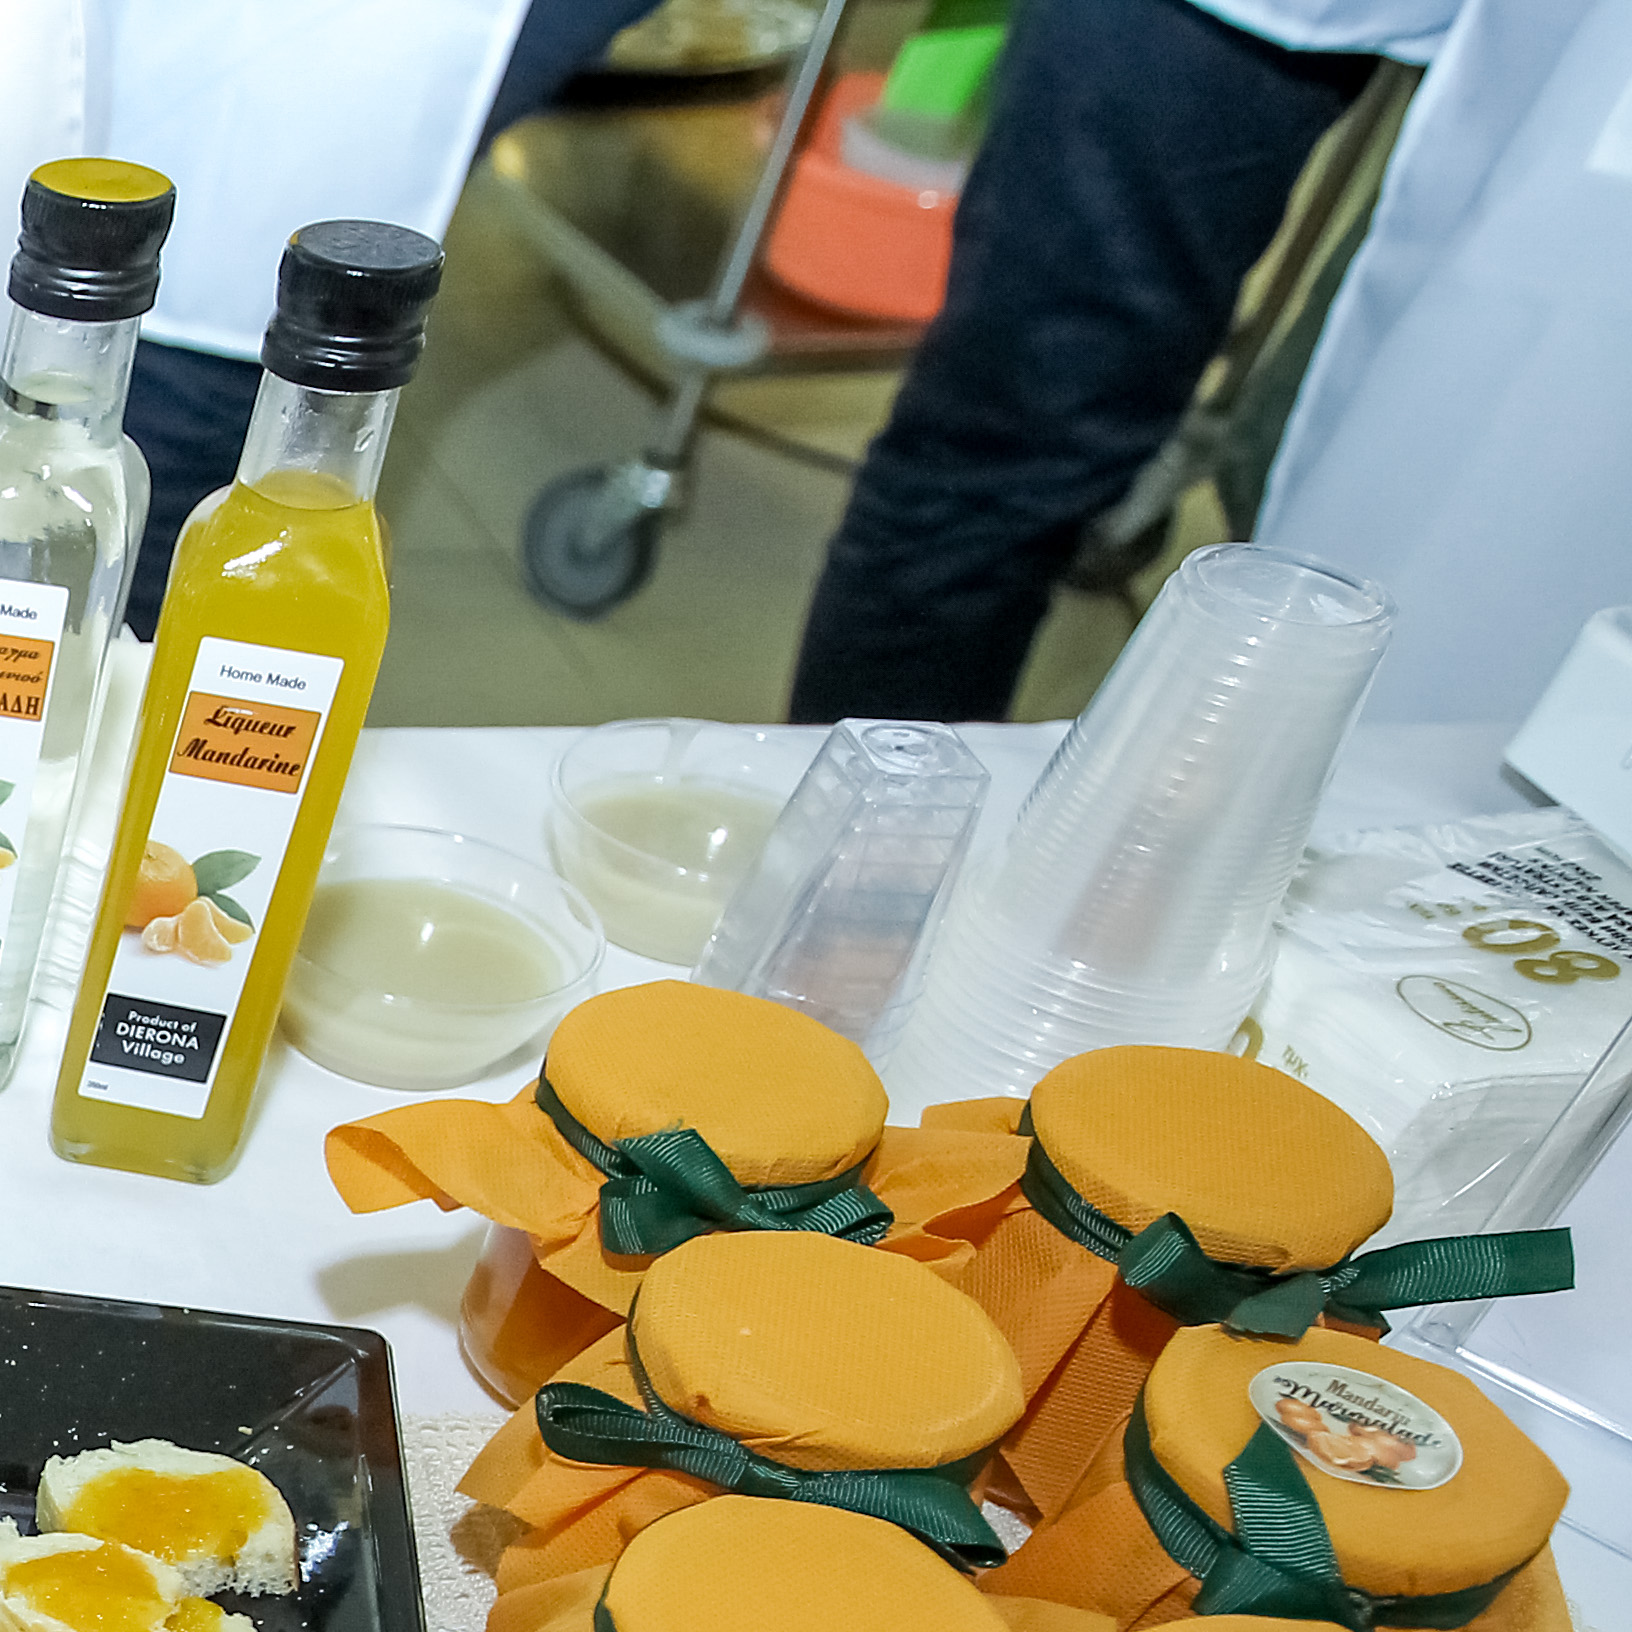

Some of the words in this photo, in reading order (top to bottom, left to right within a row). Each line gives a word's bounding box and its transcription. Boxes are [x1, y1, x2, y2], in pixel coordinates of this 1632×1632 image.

[0, 604, 38, 620] Made
[219, 664, 263, 683] Home
[265, 672, 307, 691] Made
[203, 704, 297, 739] Liqueur
[177, 737, 301, 776] Mandarine
[127, 1010, 179, 1030] Product
[181, 1021, 197, 1033] of
[116, 1021, 200, 1051] DIERONA
[121, 1039, 186, 1065] Village
